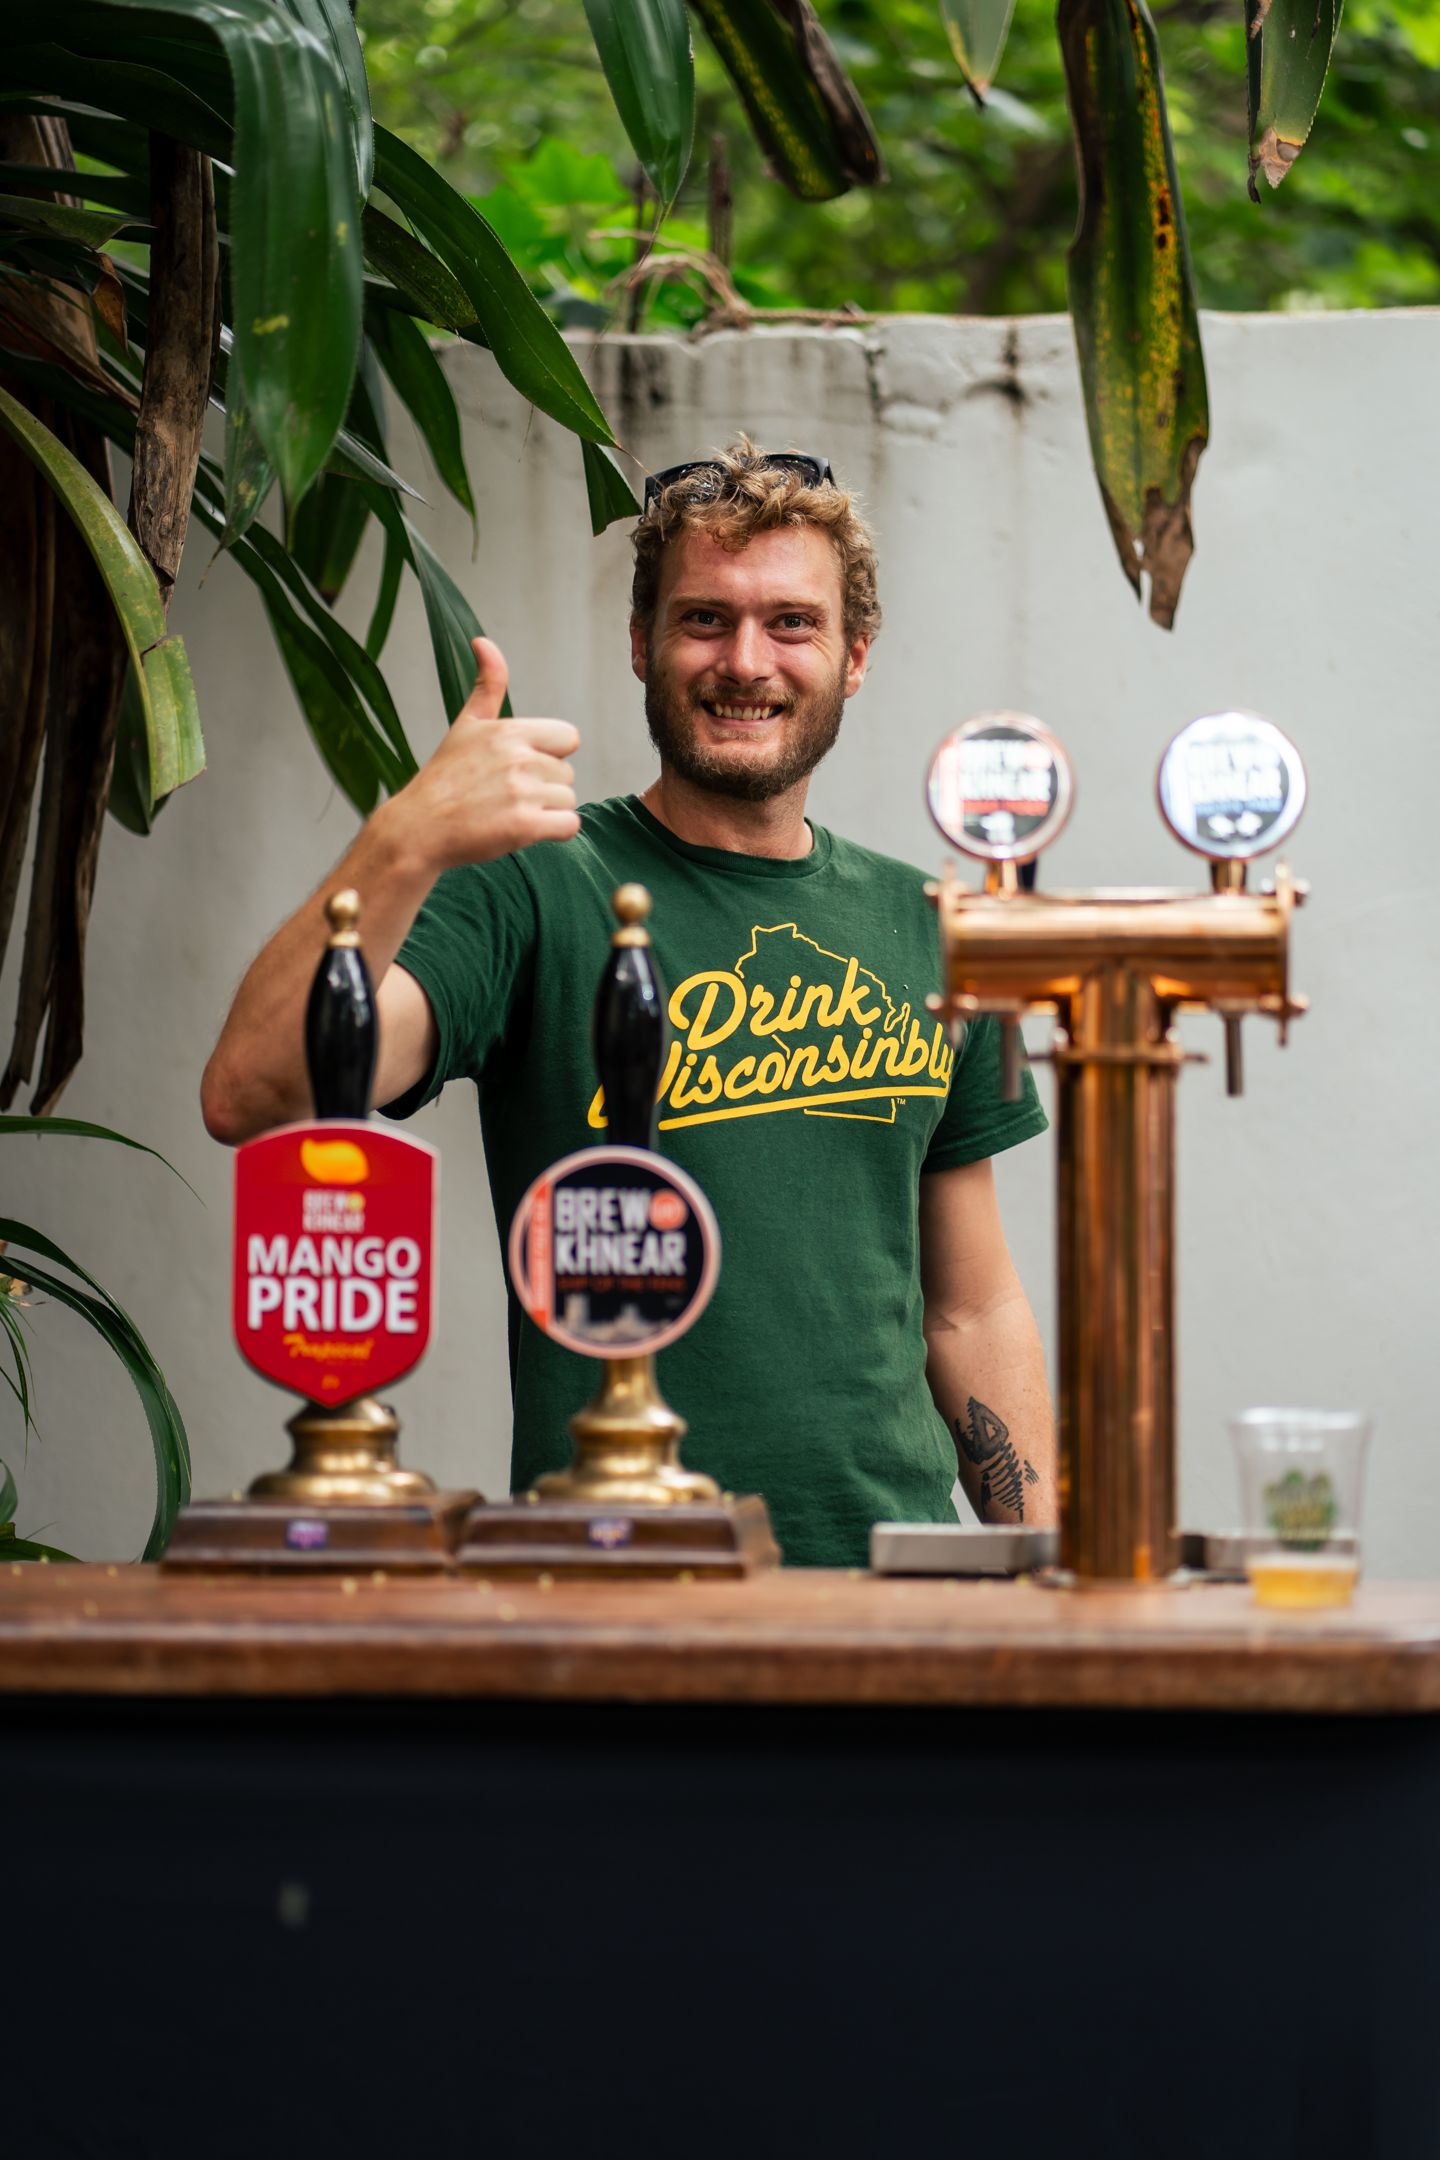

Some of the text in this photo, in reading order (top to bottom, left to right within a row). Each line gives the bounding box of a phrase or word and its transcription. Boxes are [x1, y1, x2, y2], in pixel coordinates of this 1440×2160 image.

[668, 956, 882, 1051] Drink
[555, 1187, 650, 1232] BREW
[247, 1234, 422, 1279] MANGO
[555, 1231, 688, 1276] KHNEAR
[247, 1276, 419, 1334] PRIDE
